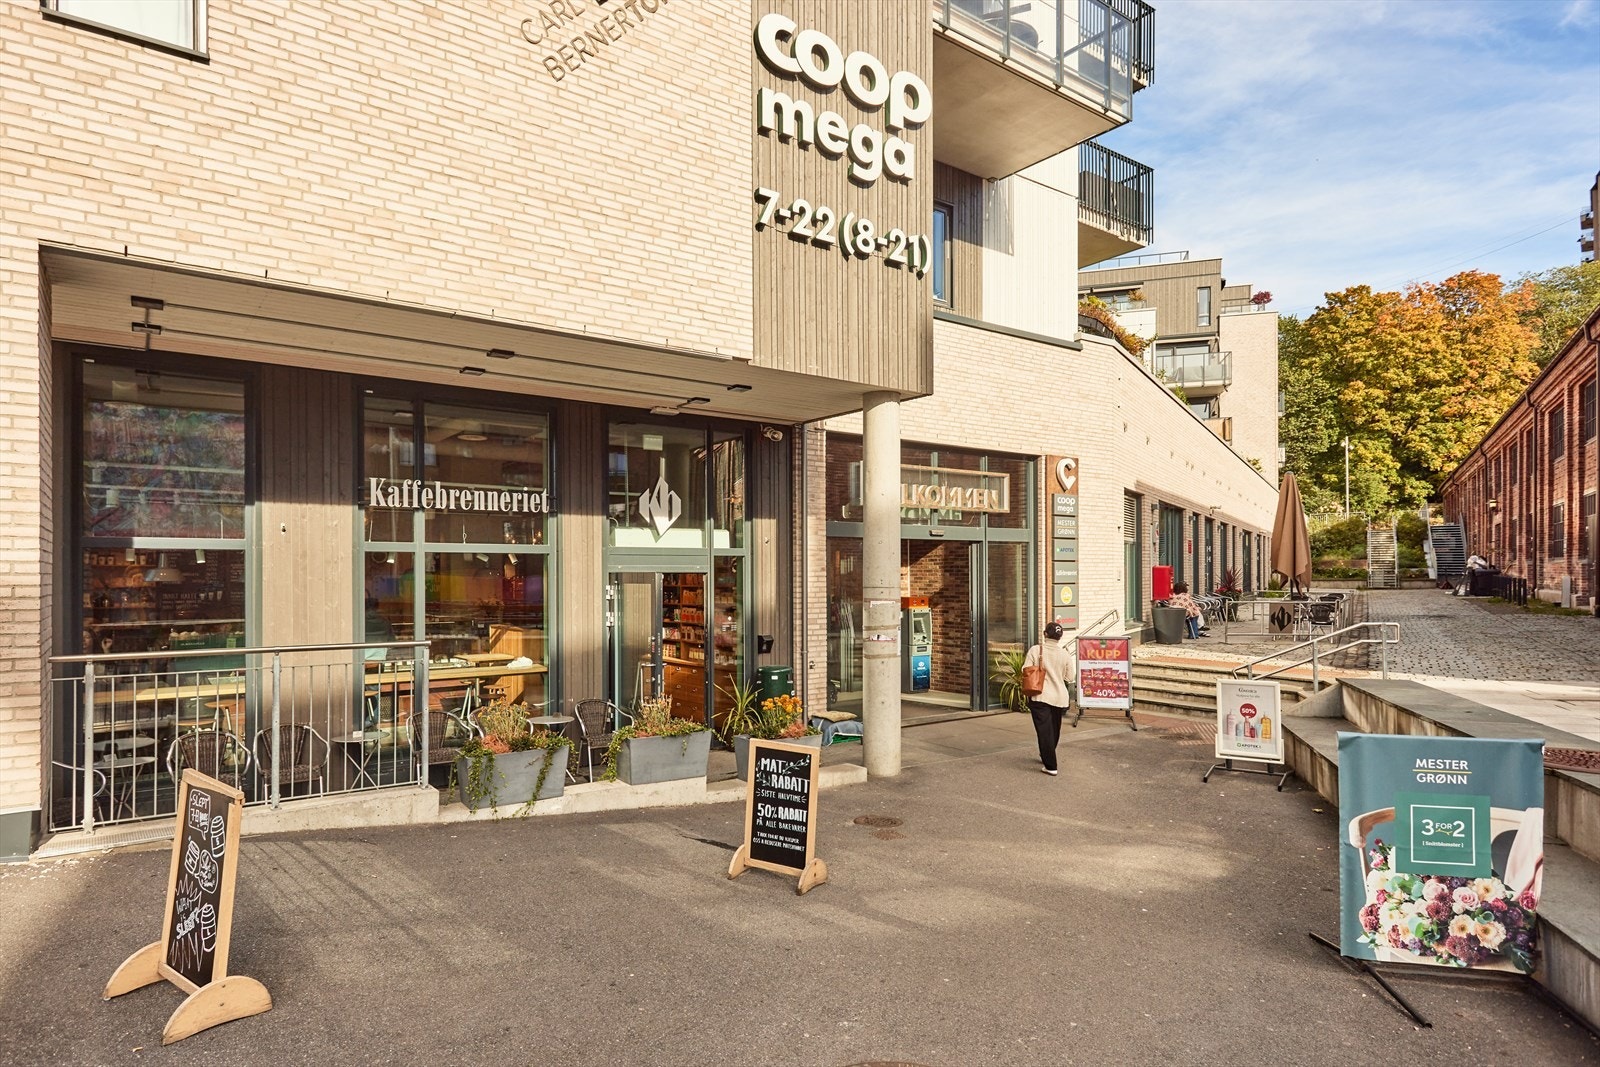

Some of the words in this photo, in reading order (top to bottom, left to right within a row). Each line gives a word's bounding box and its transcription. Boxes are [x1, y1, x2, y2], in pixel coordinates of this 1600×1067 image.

[520, 0, 585, 45] CARL
[542, 0, 668, 82] BERNERTO
[754, 13, 932, 131] coop
[757, 87, 915, 181] mega
[754, 187, 837, 245] 7-22
[840, 211, 932, 274] (8-21)
[369, 477, 550, 513] Kaffebrenneriet
[900, 484, 999, 509] LKOMMEN
[1057, 496, 1076, 506] coop
[1057, 505, 1074, 514] mega
[1057, 519, 1076, 527] MESTER
[1087, 649, 1122, 659] KUPP
[1093, 688, 1116, 698] -40%
[1241, 707, 1256, 715] 50%
[760, 757, 786, 774] MAT
[1415, 758, 1469, 770] MESTER
[771, 774, 810, 794] RABATT
[1416, 773, 1468, 785] GRØNN
[761, 789, 776, 799] SISTE
[757, 802, 778, 819] 50%
[777, 806, 808, 823] RABATT
[1421, 819, 1435, 836] 3
[1435, 822, 1453, 830] FOR
[1452, 820, 1466, 837] 2
